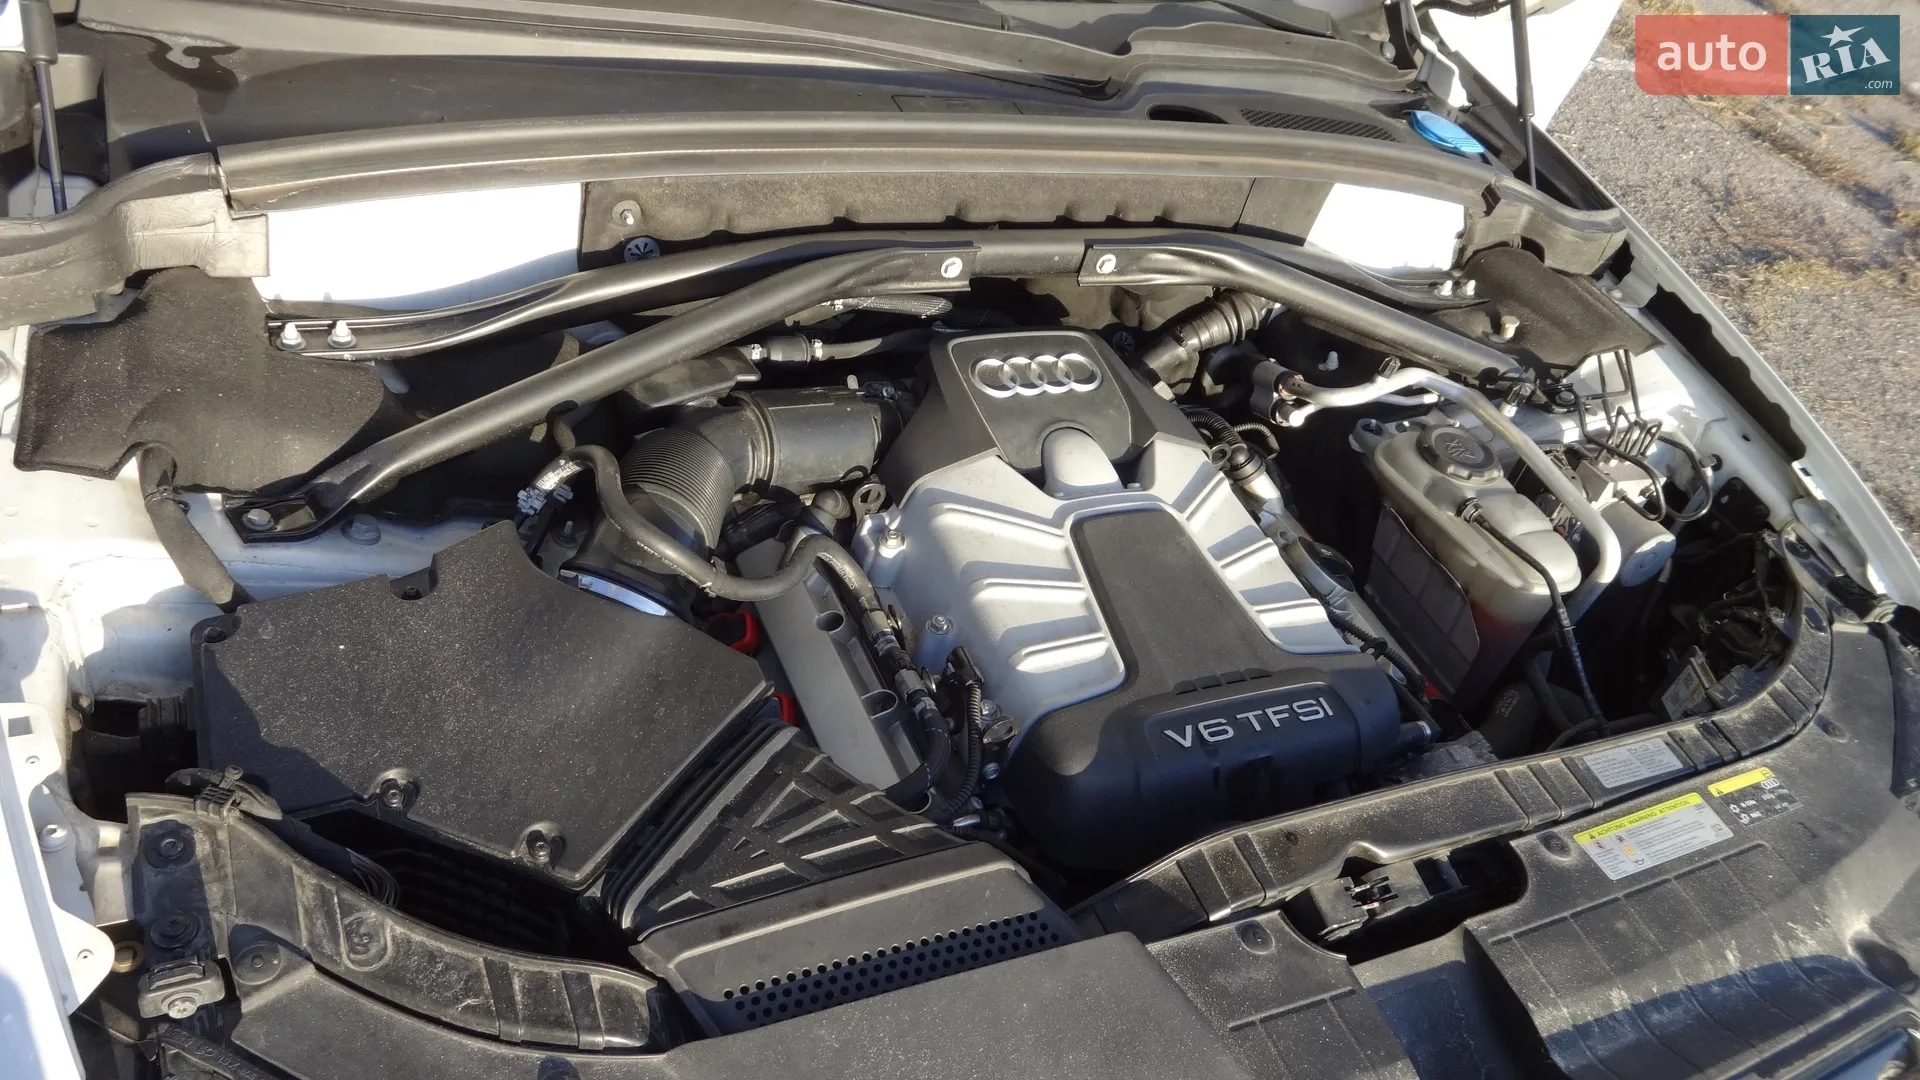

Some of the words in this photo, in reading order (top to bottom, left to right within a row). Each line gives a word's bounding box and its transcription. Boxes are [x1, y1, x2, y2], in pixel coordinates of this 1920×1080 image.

[1163, 718, 1234, 748] V6
[1235, 697, 1334, 732] TFSI
[1597, 822, 1627, 837] ACHTUNG
[1628, 811, 1657, 825] WARNING
[1658, 801, 1690, 815] ATTENTION
